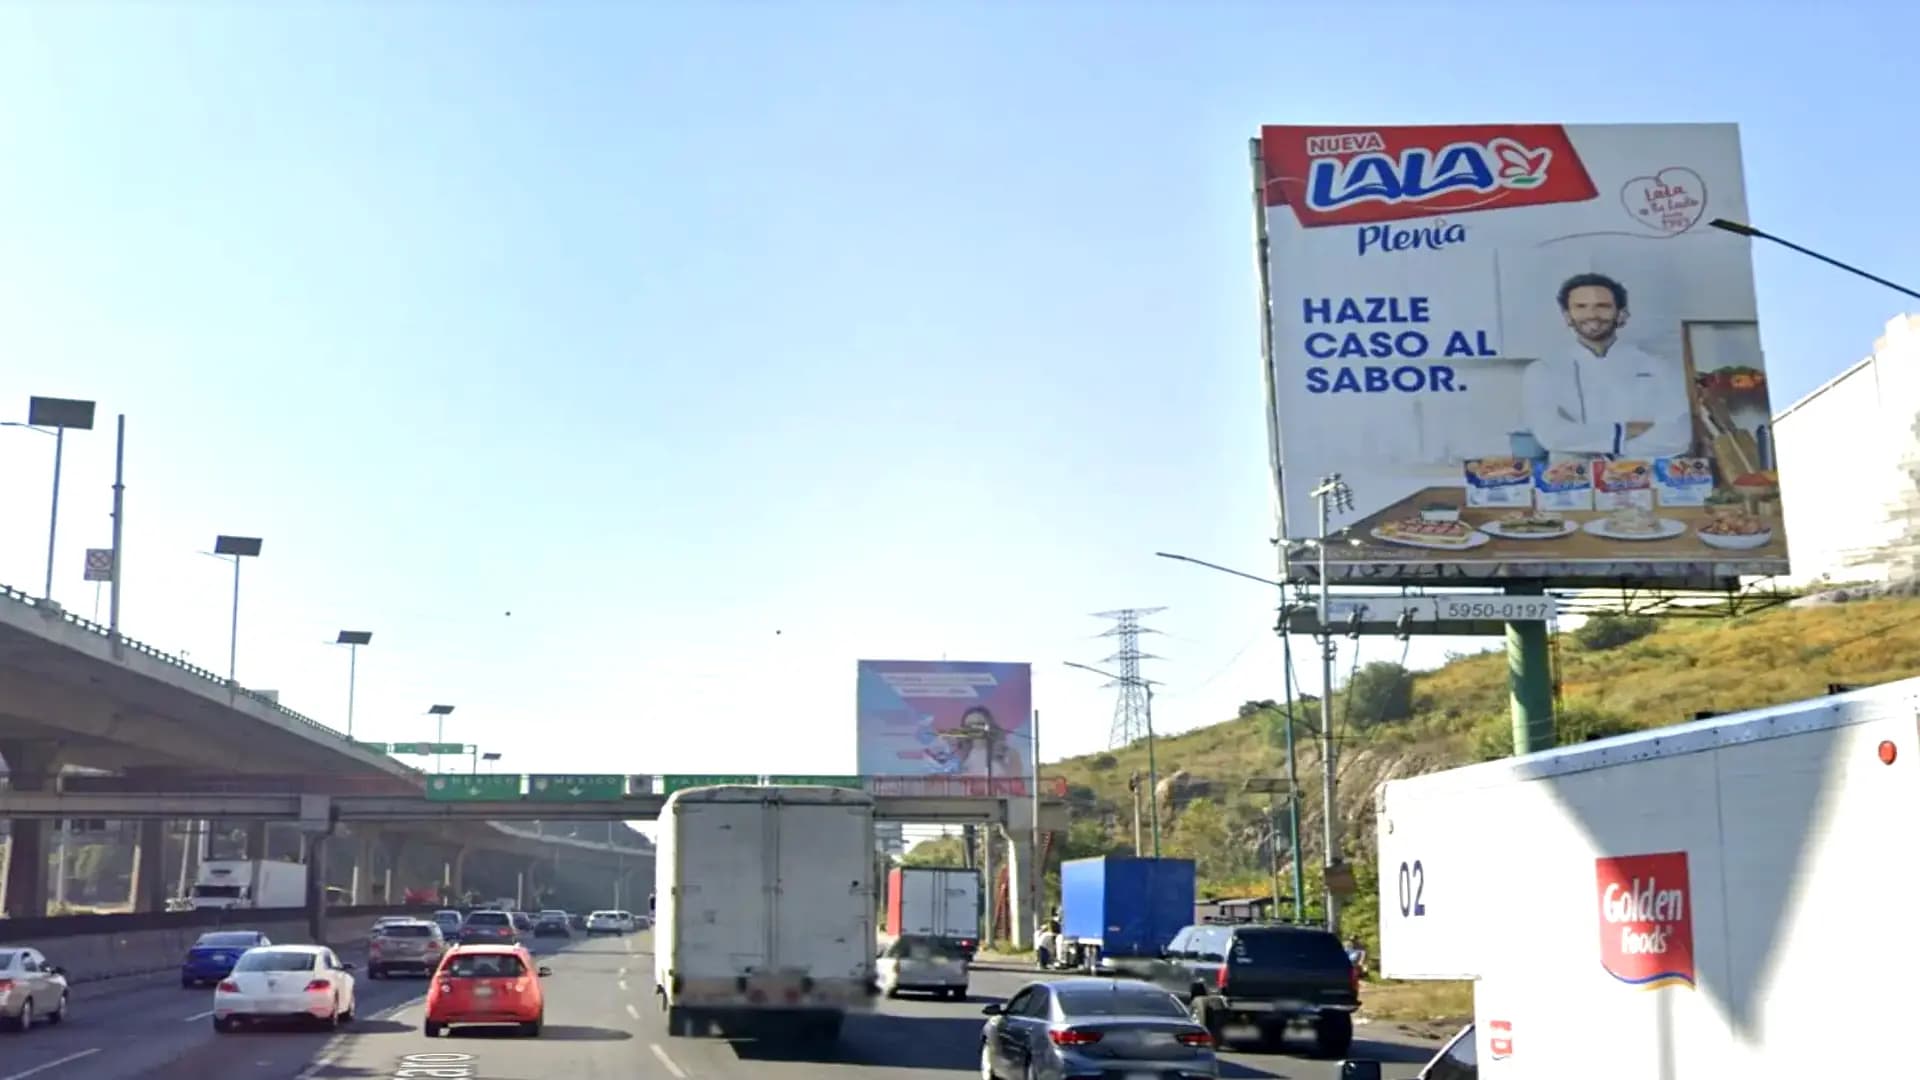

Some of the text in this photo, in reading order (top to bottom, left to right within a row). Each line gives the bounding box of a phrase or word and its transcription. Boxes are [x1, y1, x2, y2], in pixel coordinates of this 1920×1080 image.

[1309, 134, 1382, 153] NUEVA
[1309, 145, 1496, 210] LALA
[1358, 219, 1466, 256] Plenia
[1303, 297, 1430, 324] HAZLE
[1305, 330, 1497, 358] CASO AL
[1306, 366, 1467, 393] SABOR.
[1449, 603, 1548, 618] 5950-0197
[1399, 860, 1425, 917] 02
[1603, 877, 1683, 923] Golden
